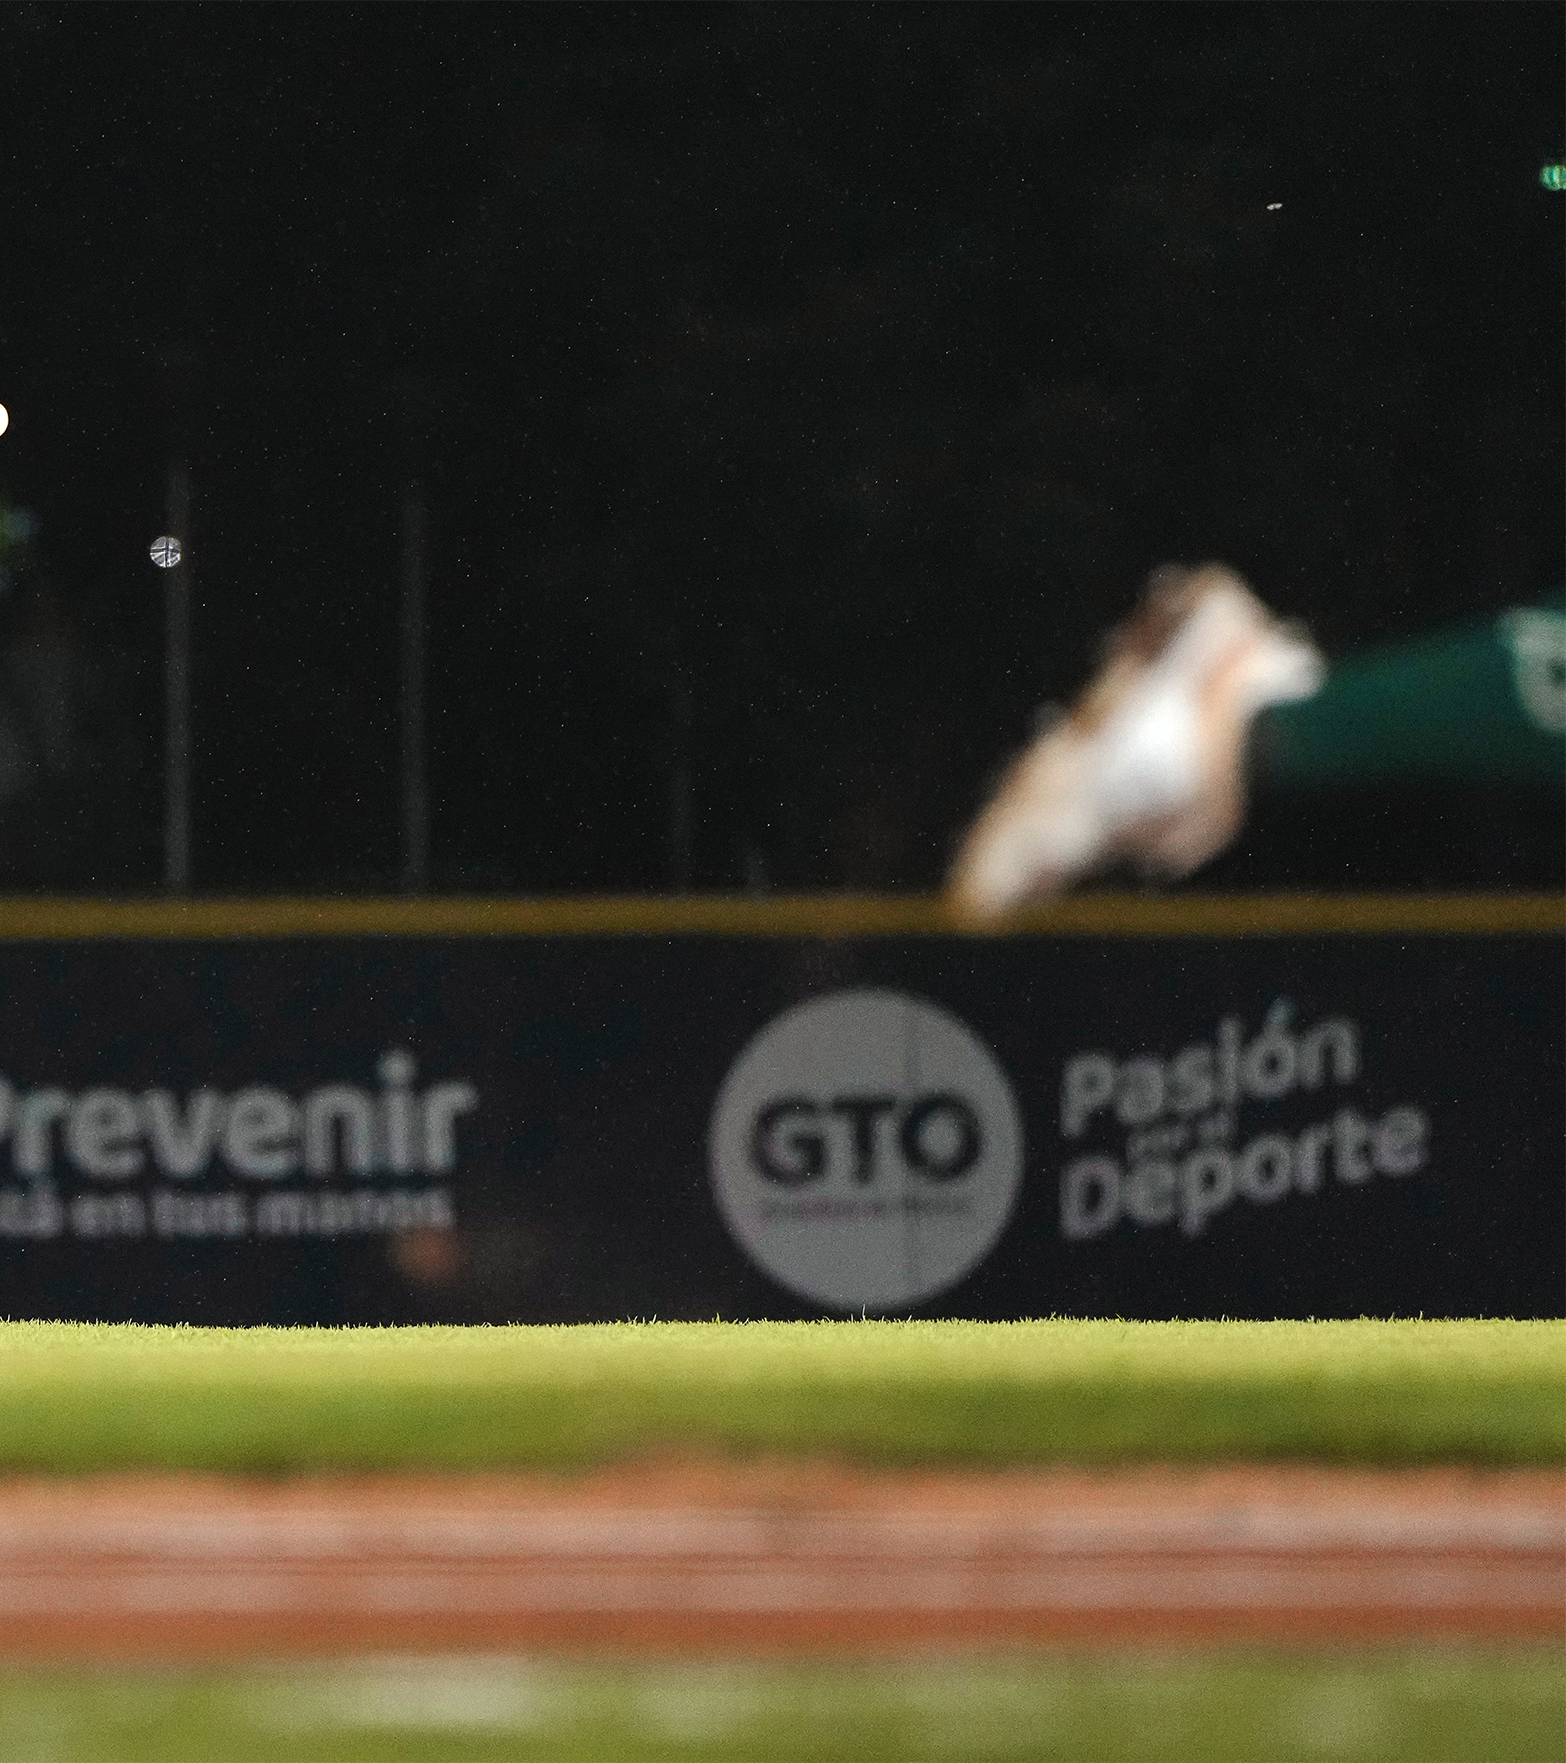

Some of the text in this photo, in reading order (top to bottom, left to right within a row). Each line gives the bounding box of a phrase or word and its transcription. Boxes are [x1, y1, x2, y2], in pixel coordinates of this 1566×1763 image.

[1062, 998, 1360, 1136] Pasión
[752, 1098, 984, 1184] GTO
[1060, 1104, 1428, 1240] Deporte
